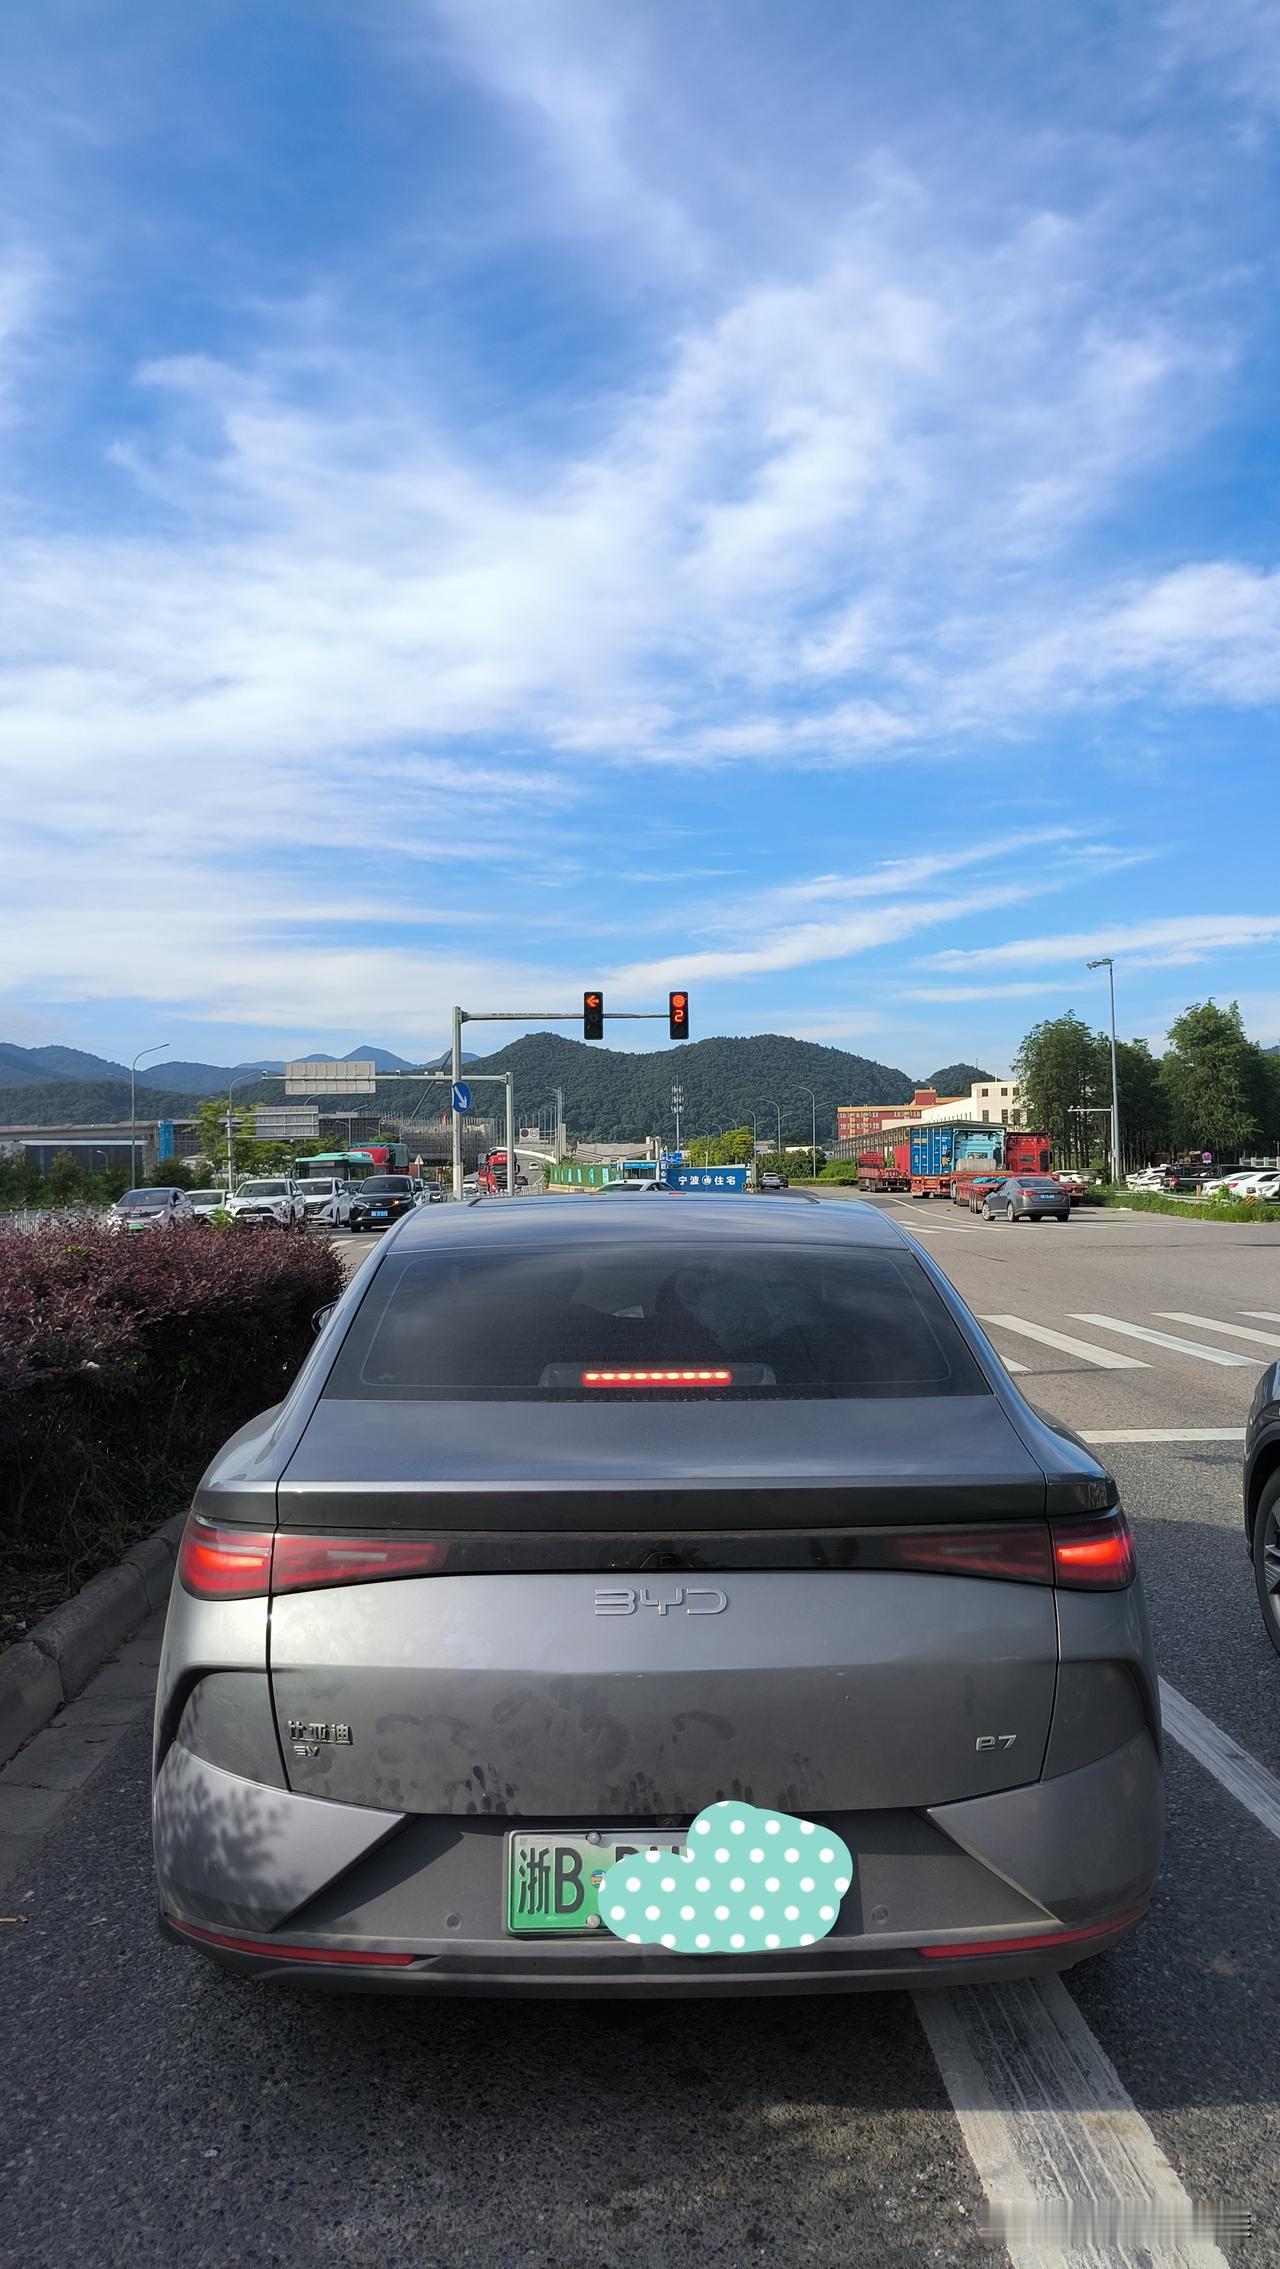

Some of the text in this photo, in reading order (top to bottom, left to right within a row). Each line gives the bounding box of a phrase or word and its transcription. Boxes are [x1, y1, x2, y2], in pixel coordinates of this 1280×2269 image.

[674, 1009, 684, 1022] 2
[595, 1588, 727, 1615] BYD
[288, 1720, 353, 1744] 比亚迪
[294, 1745, 319, 1757] EV
